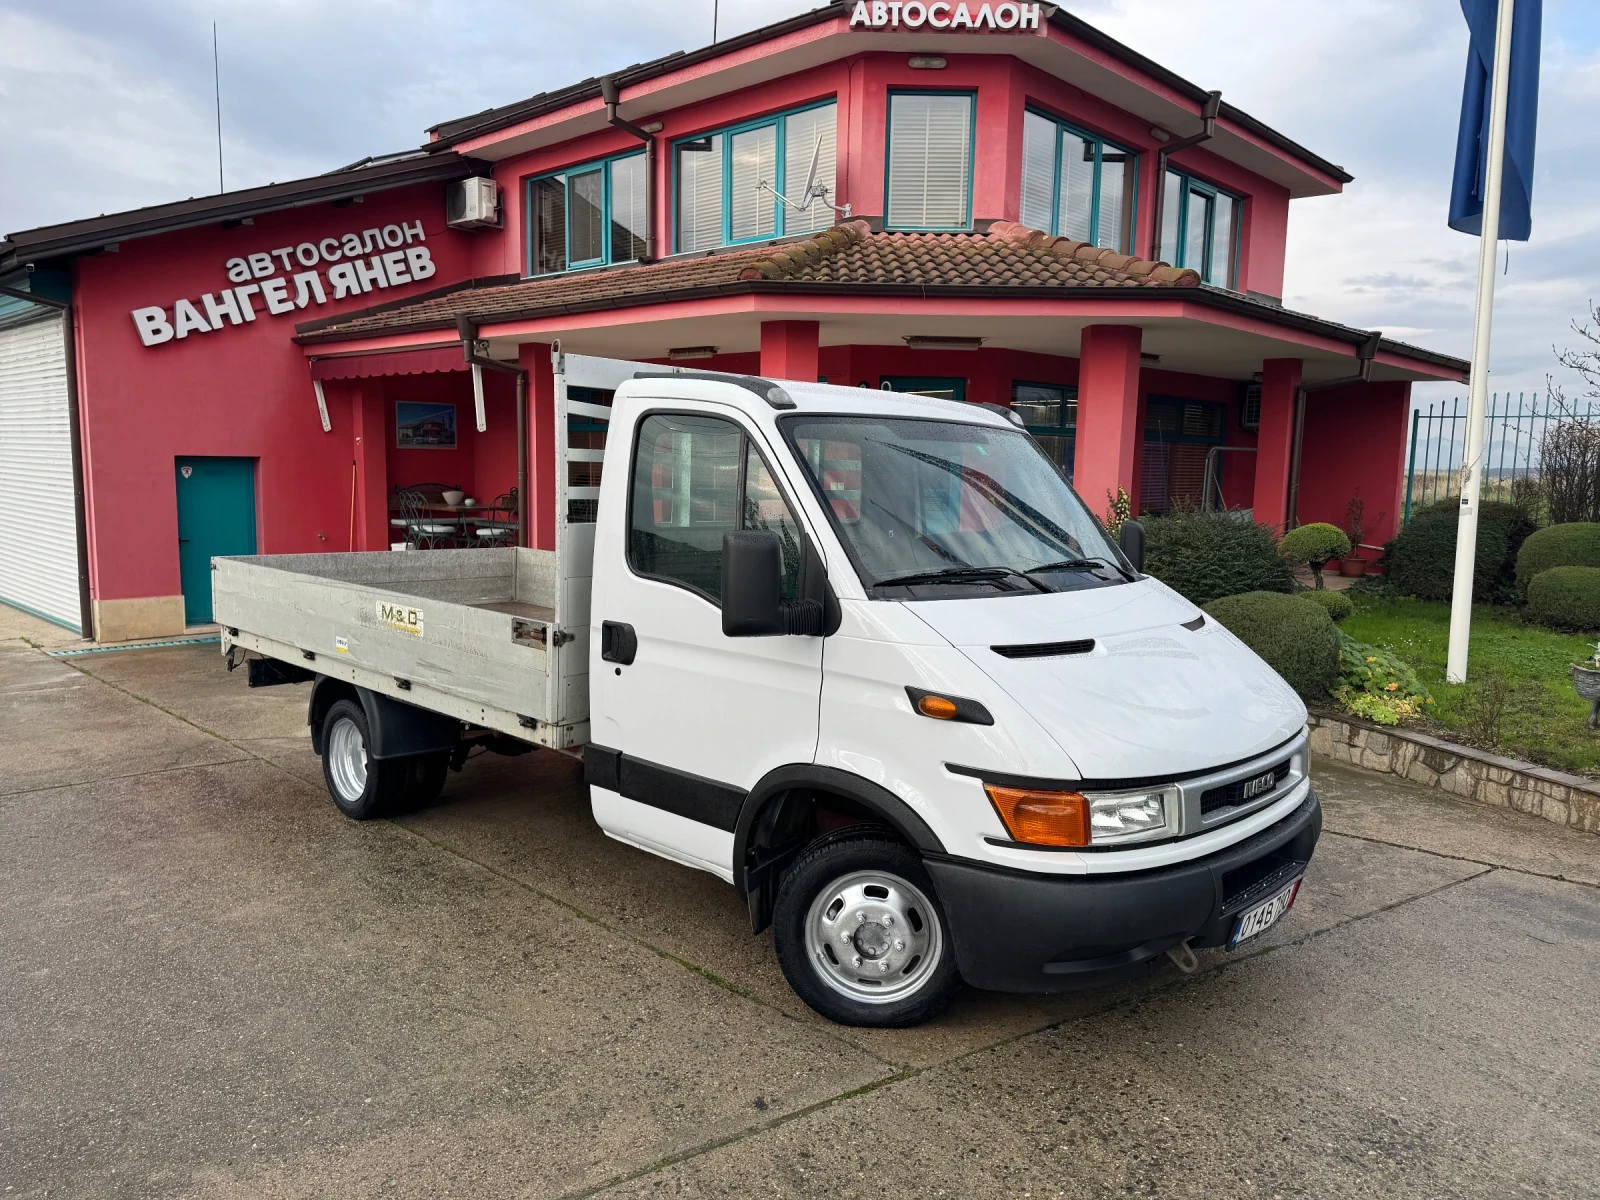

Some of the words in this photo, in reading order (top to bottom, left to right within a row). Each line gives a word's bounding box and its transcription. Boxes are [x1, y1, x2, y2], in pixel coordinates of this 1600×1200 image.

[850, 1, 1040, 31] АВТОСАЛОН
[225, 219, 427, 284] автосалон
[130, 271, 327, 347] ВАНГЕЛ
[327, 245, 437, 300] ЯНЕВ
[1243, 771, 1275, 799] IVECO
